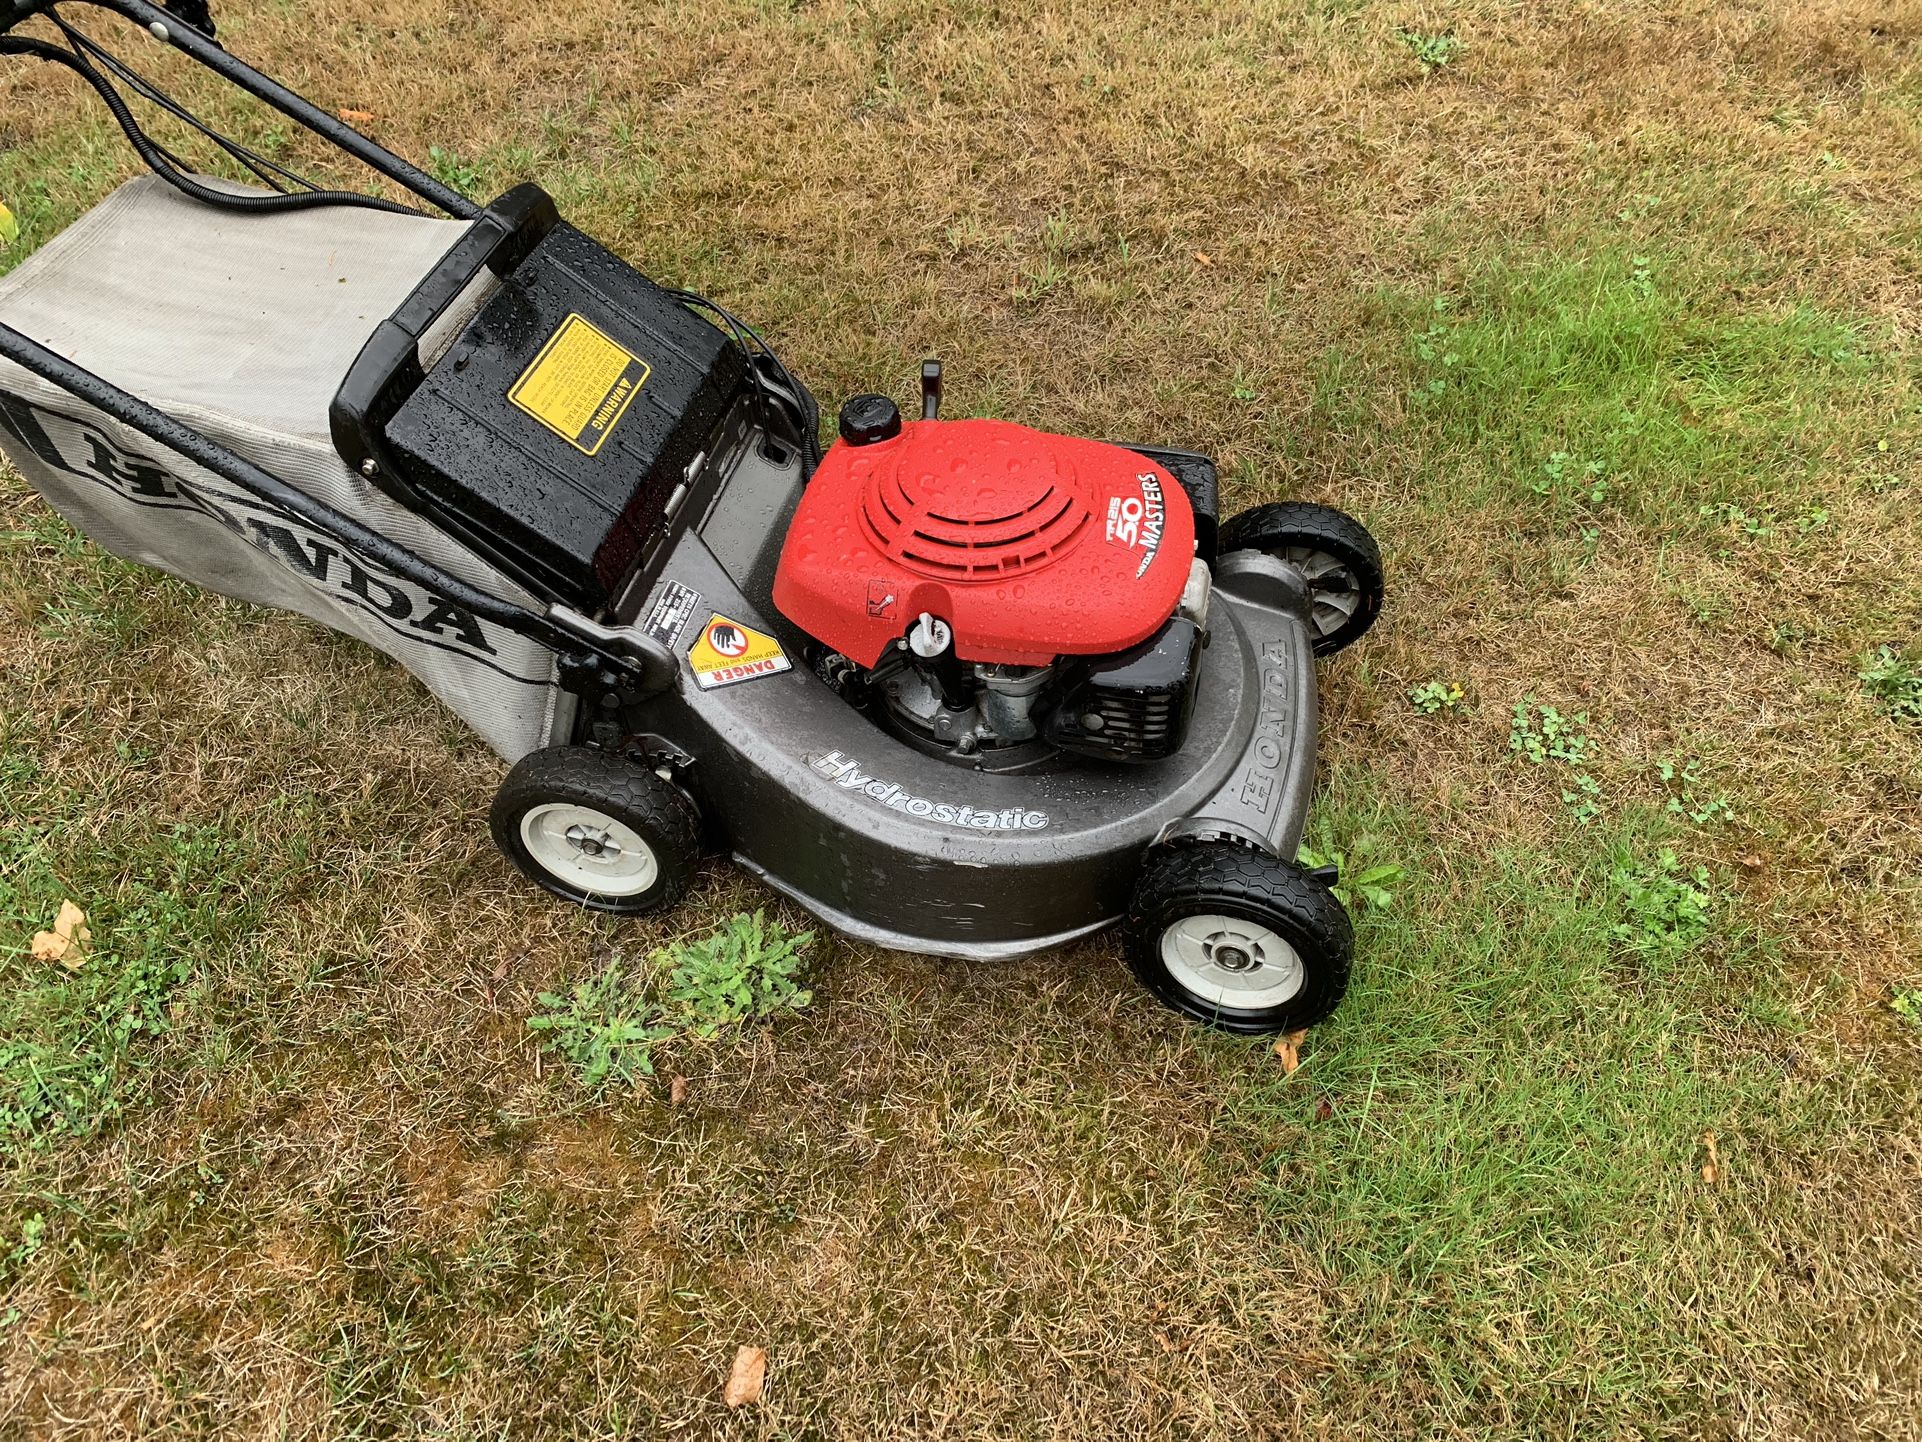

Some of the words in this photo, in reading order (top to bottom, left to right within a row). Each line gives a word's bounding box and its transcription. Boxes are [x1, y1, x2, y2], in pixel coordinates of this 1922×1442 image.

[596, 358, 613, 378] CLOSED
[615, 358, 625, 368] DO
[608, 366, 619, 378] NOT
[590, 375, 601, 386] OR
[597, 376, 612, 393] START
[583, 383, 595, 396] BAG
[574, 400, 583, 409] IN
[578, 394, 588, 403] IS
[583, 392, 601, 413] UNLESS
[590, 384, 627, 431] WARNING
[570, 411, 587, 431] GUARD
[1136, 472, 1165, 549] MASTERS
[742, 653, 763, 662] HANDS
[764, 649, 780, 657] KEEP
[696, 663, 712, 671] AWAY
[711, 659, 775, 682] DANGER
[1240, 639, 1288, 814] HONDA
[812, 749, 1050, 830] Hydrostatic
